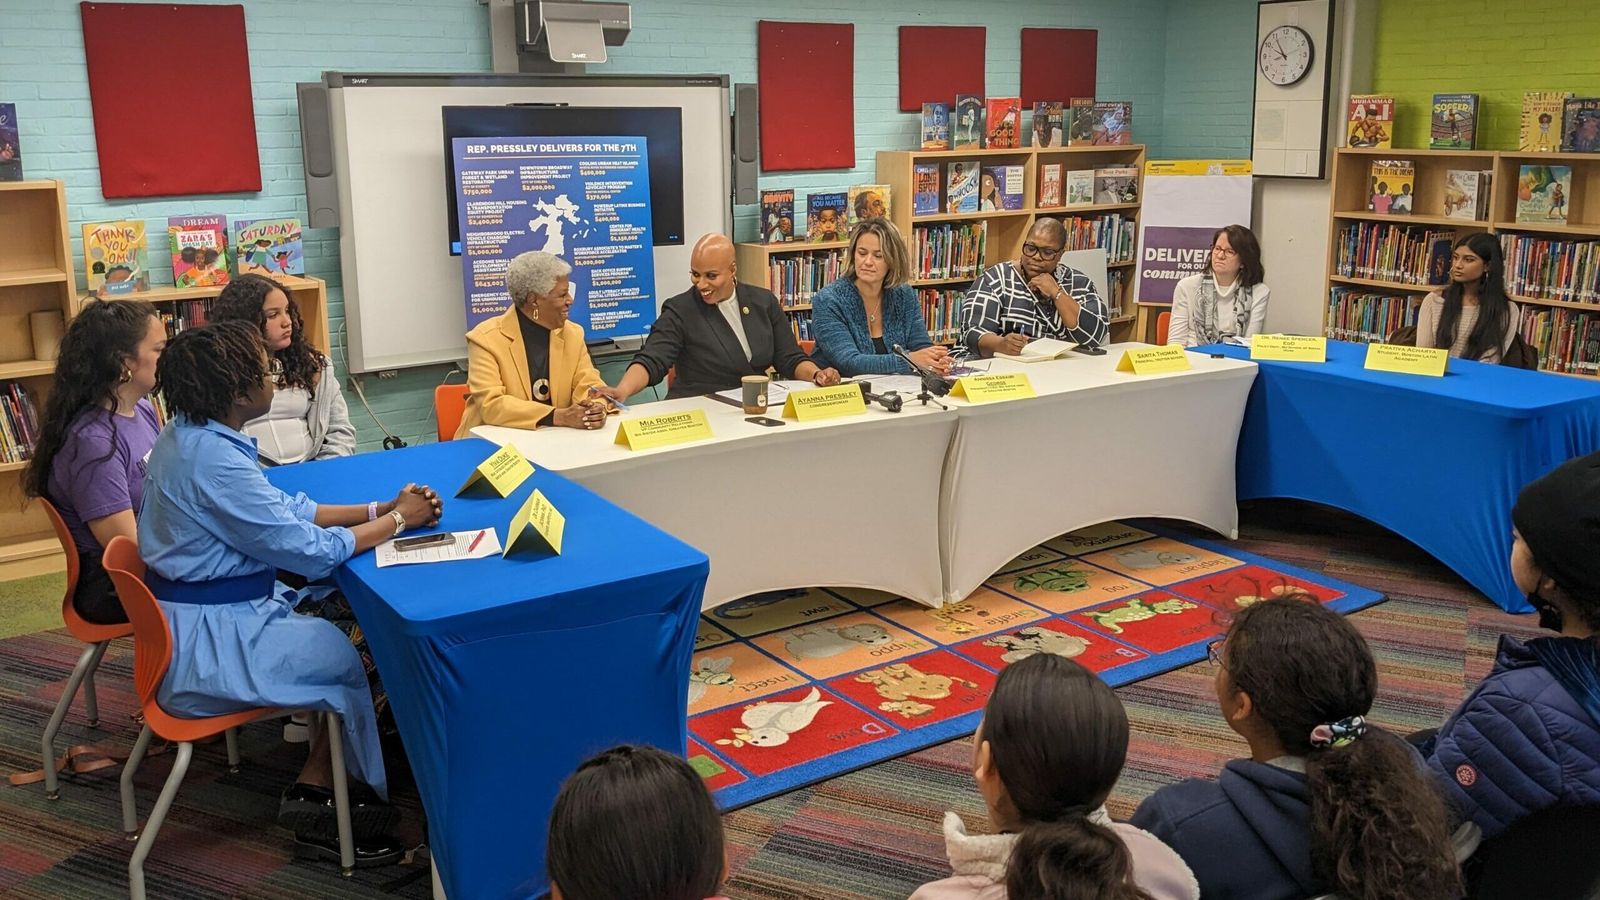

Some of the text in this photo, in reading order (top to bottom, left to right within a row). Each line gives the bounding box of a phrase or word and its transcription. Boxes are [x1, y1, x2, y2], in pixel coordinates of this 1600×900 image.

[1352, 104, 1389, 120] ALI
[467, 145, 488, 153] REP.
[491, 144, 538, 153] PRESSLEY
[540, 144, 583, 152] DELIVERS
[621, 144, 636, 152] 7TH
[919, 173, 936, 182] LONG
[919, 183, 936, 192] SHOT
[183, 218, 218, 226] DREAM
[91, 228, 136, 243] THANK
[180, 234, 213, 242] ZARA'S
[240, 223, 294, 242] SATURDAY
[105, 241, 128, 253] YOU
[109, 248, 136, 264] OMU!
[798, 391, 858, 404] AYANNA PRESSLEY
[809, 400, 848, 408] CONGRESSWOMAN
[656, 414, 691, 424] ROBERTS
[986, 608, 1040, 627] Giraffe
[870, 640, 926, 658] Hippo
[742, 674, 795, 693] Insect
